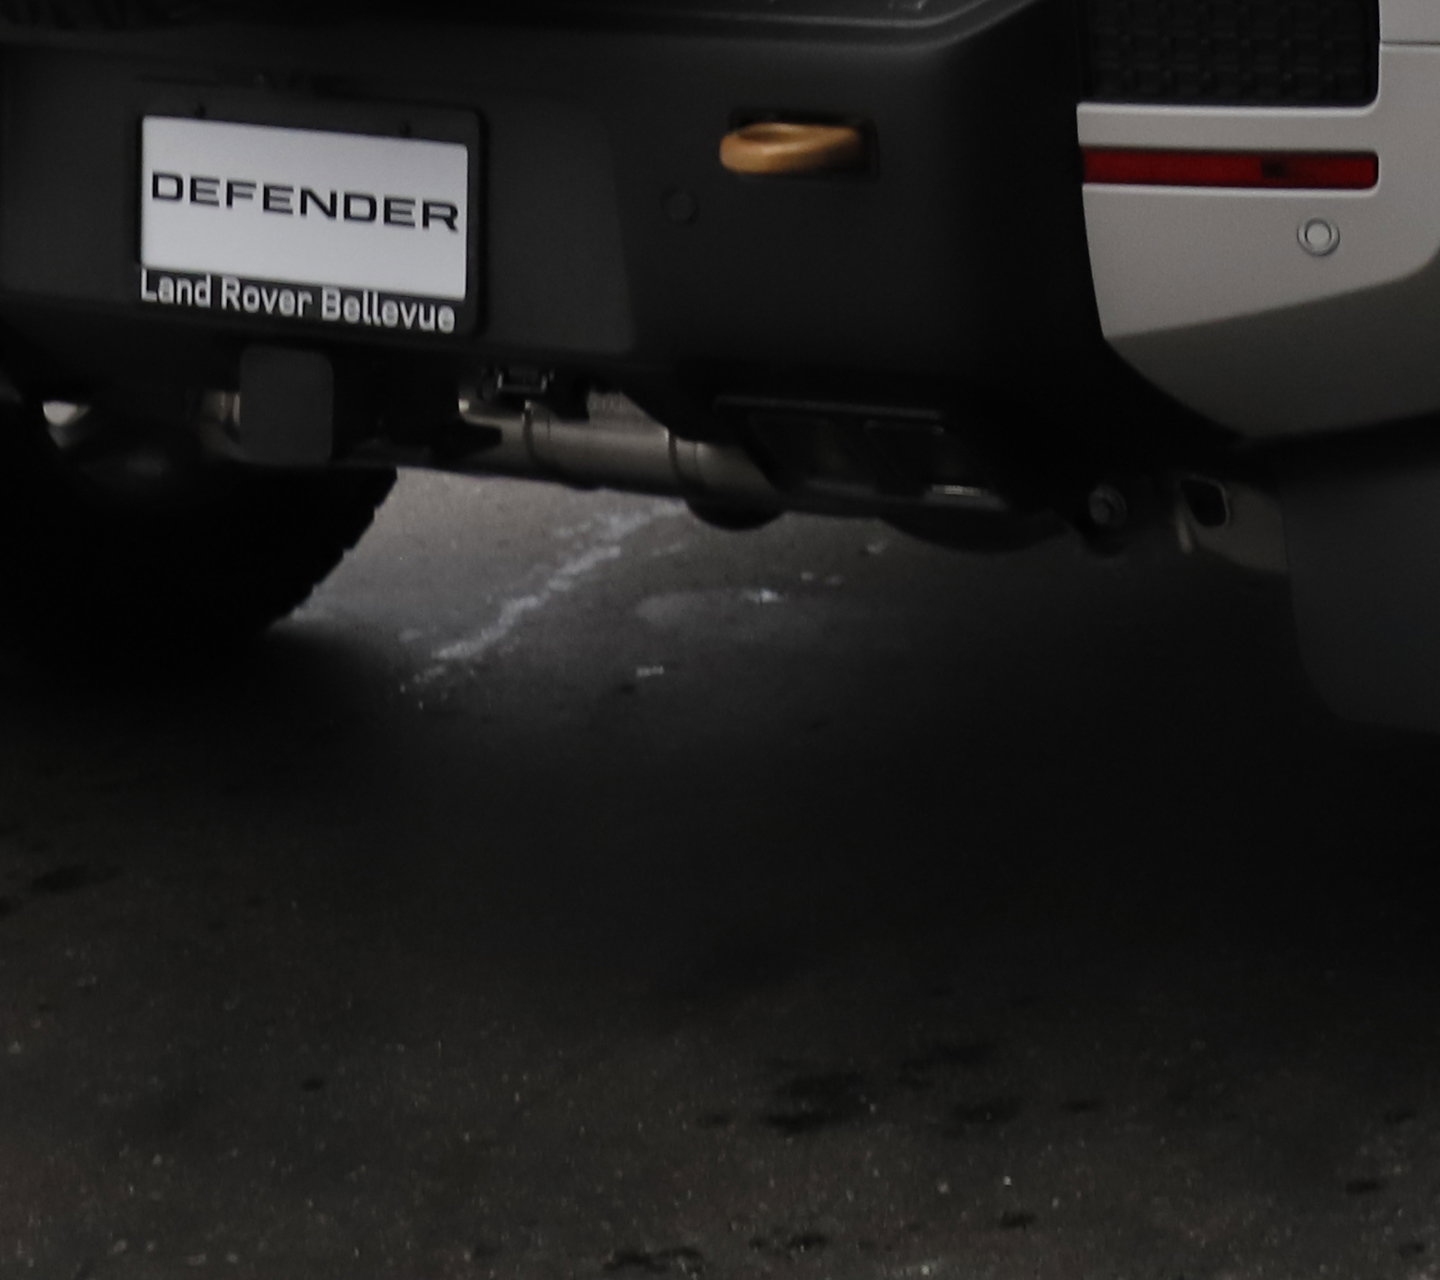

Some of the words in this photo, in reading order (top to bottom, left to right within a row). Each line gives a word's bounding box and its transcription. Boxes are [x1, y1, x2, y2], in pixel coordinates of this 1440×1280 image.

[151, 171, 458, 231] DEFENDER
[140, 268, 211, 309] Land
[221, 276, 313, 317] Rover
[321, 285, 456, 333] Bellevue
